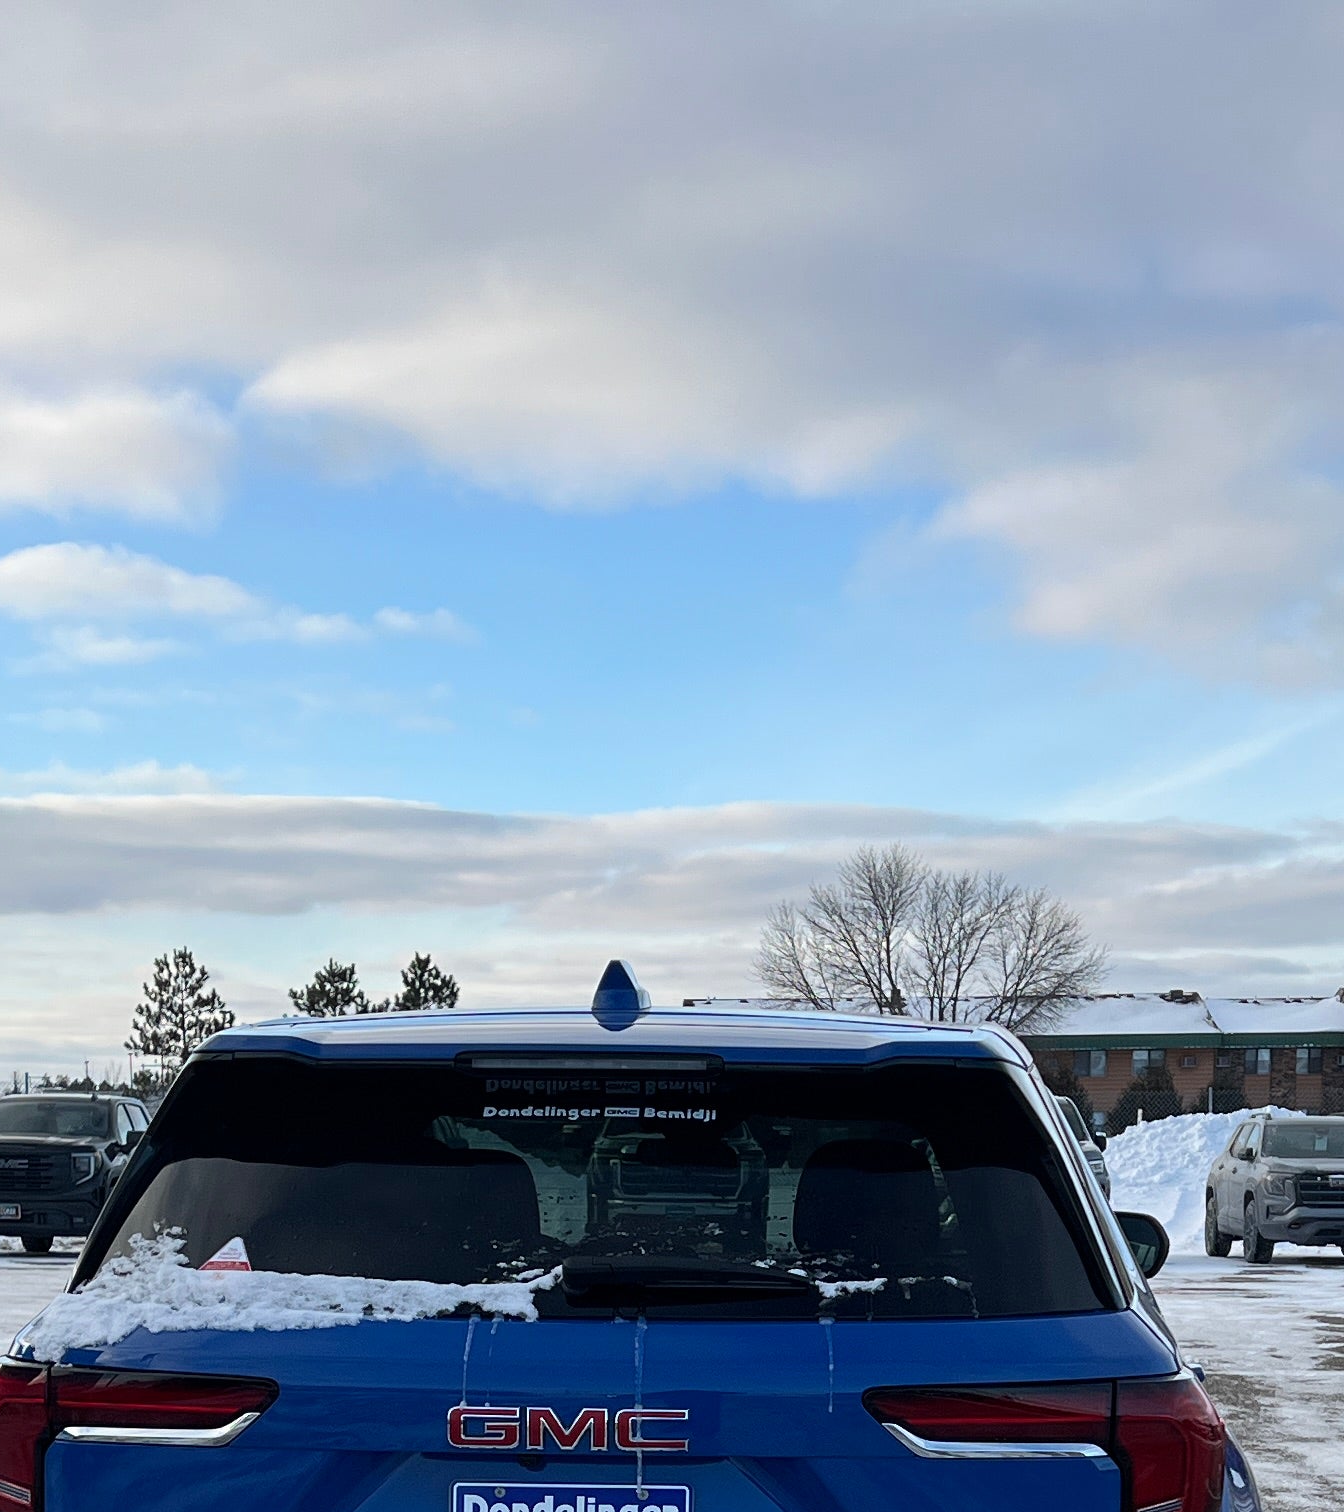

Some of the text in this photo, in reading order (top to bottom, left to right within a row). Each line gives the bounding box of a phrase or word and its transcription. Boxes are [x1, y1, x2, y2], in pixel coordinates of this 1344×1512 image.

[483, 1106, 600, 1120] Dondelinger
[644, 1107, 716, 1122] Bemidji
[447, 1405, 690, 1452] GMC
